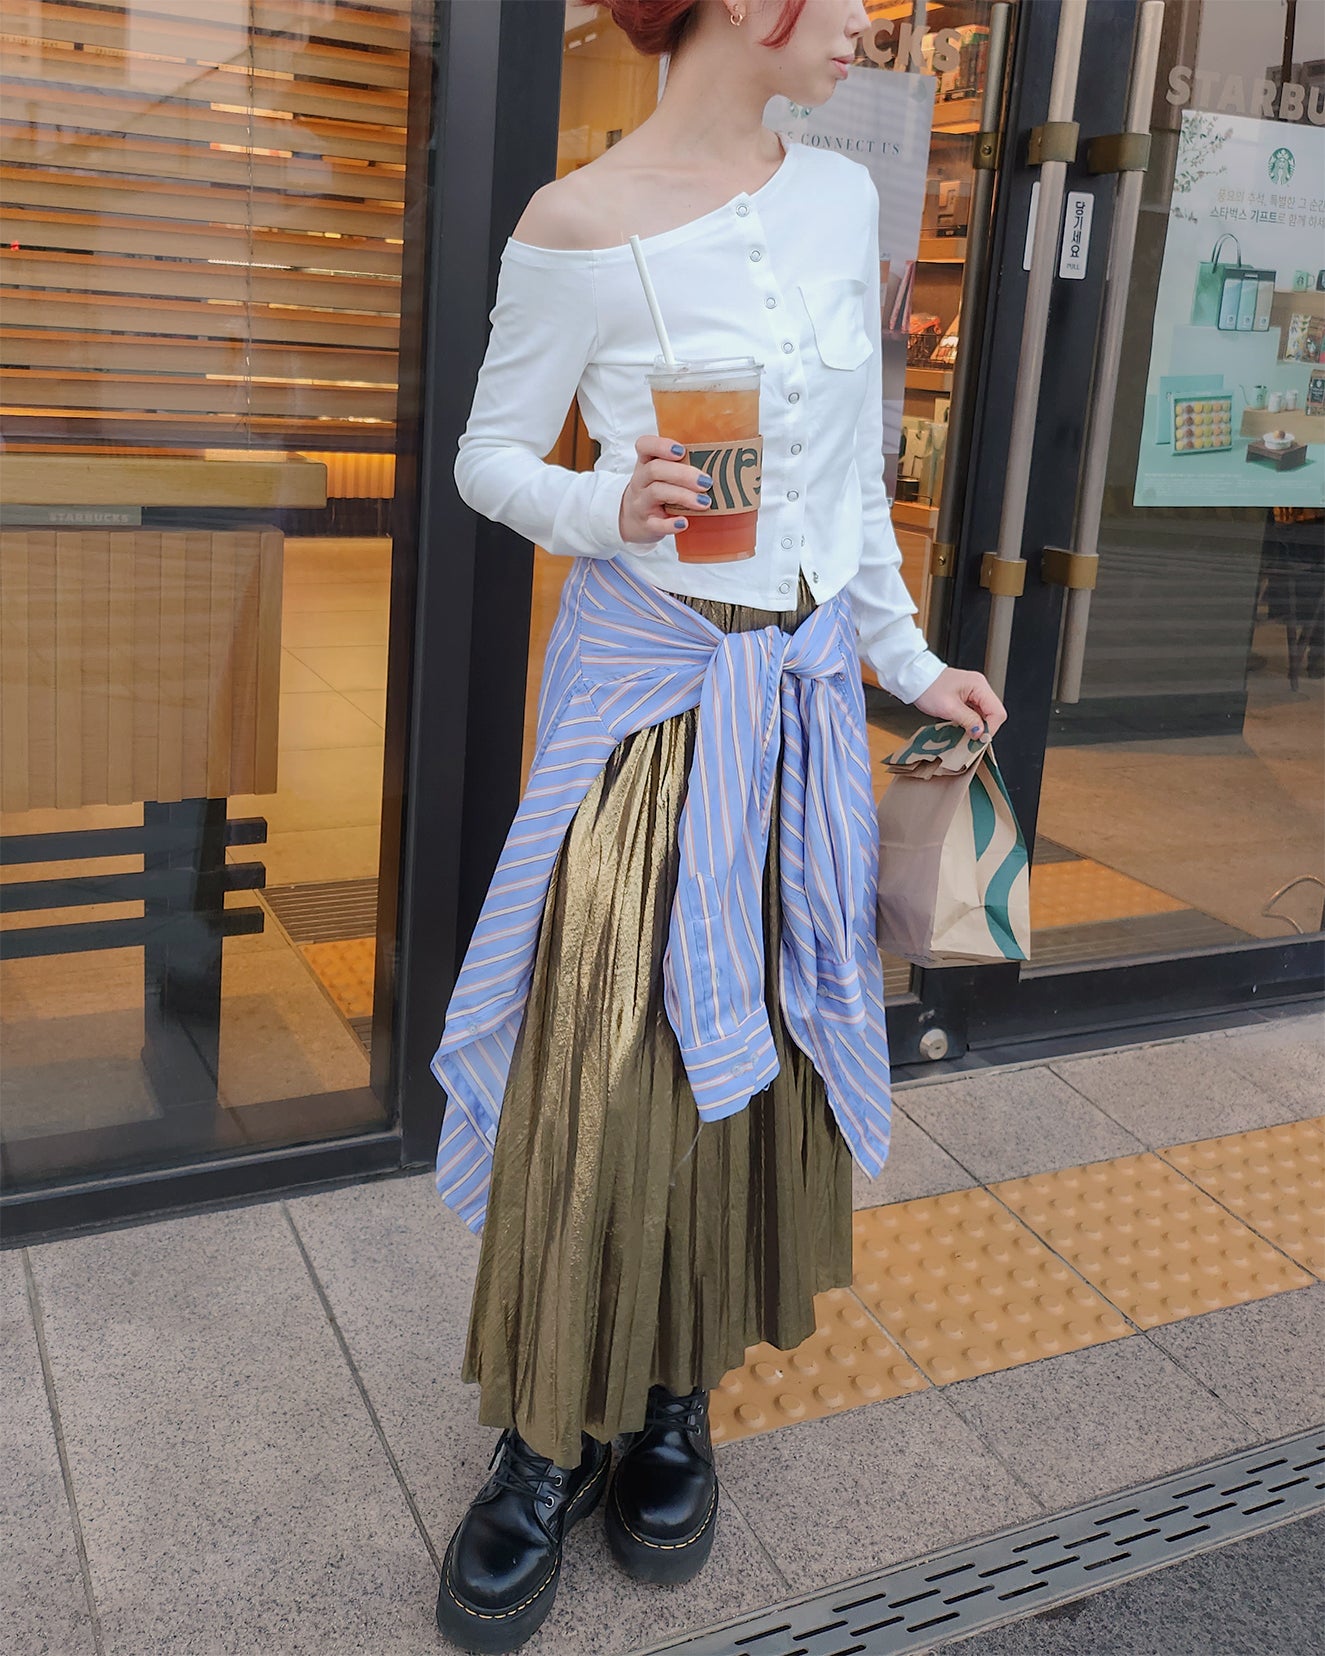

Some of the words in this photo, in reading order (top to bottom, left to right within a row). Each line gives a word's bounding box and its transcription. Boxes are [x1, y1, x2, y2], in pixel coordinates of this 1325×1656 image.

[801, 134, 875, 152] CONNECT
[882, 142, 900, 154] US
[1271, 194, 1296, 209] 특별한
[1209, 206, 1247, 220] 스타벅스
[1069, 201, 1086, 258] 당기세요
[47, 511, 129, 523] STARBUCKS
